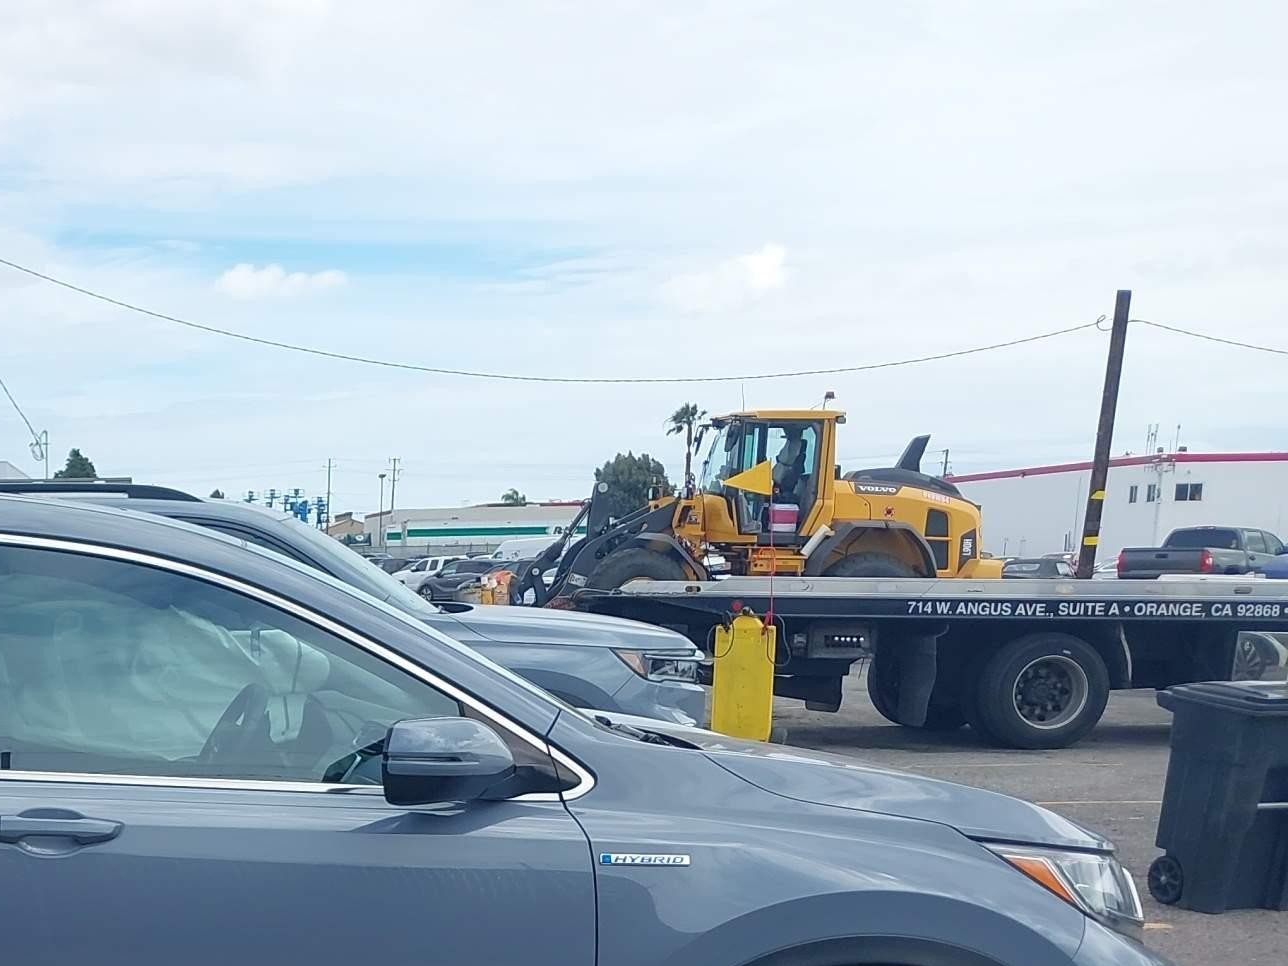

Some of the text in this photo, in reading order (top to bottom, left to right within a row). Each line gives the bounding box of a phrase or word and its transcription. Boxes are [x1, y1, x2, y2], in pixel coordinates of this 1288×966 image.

[857, 485, 897, 494] VOLVO
[962, 538, 973, 556] L90H
[908, 601, 1280, 618] 714 W. ANGUS AVE., SUITE A ORANGE, CA 92868
[614, 855, 684, 864] HYBRID
